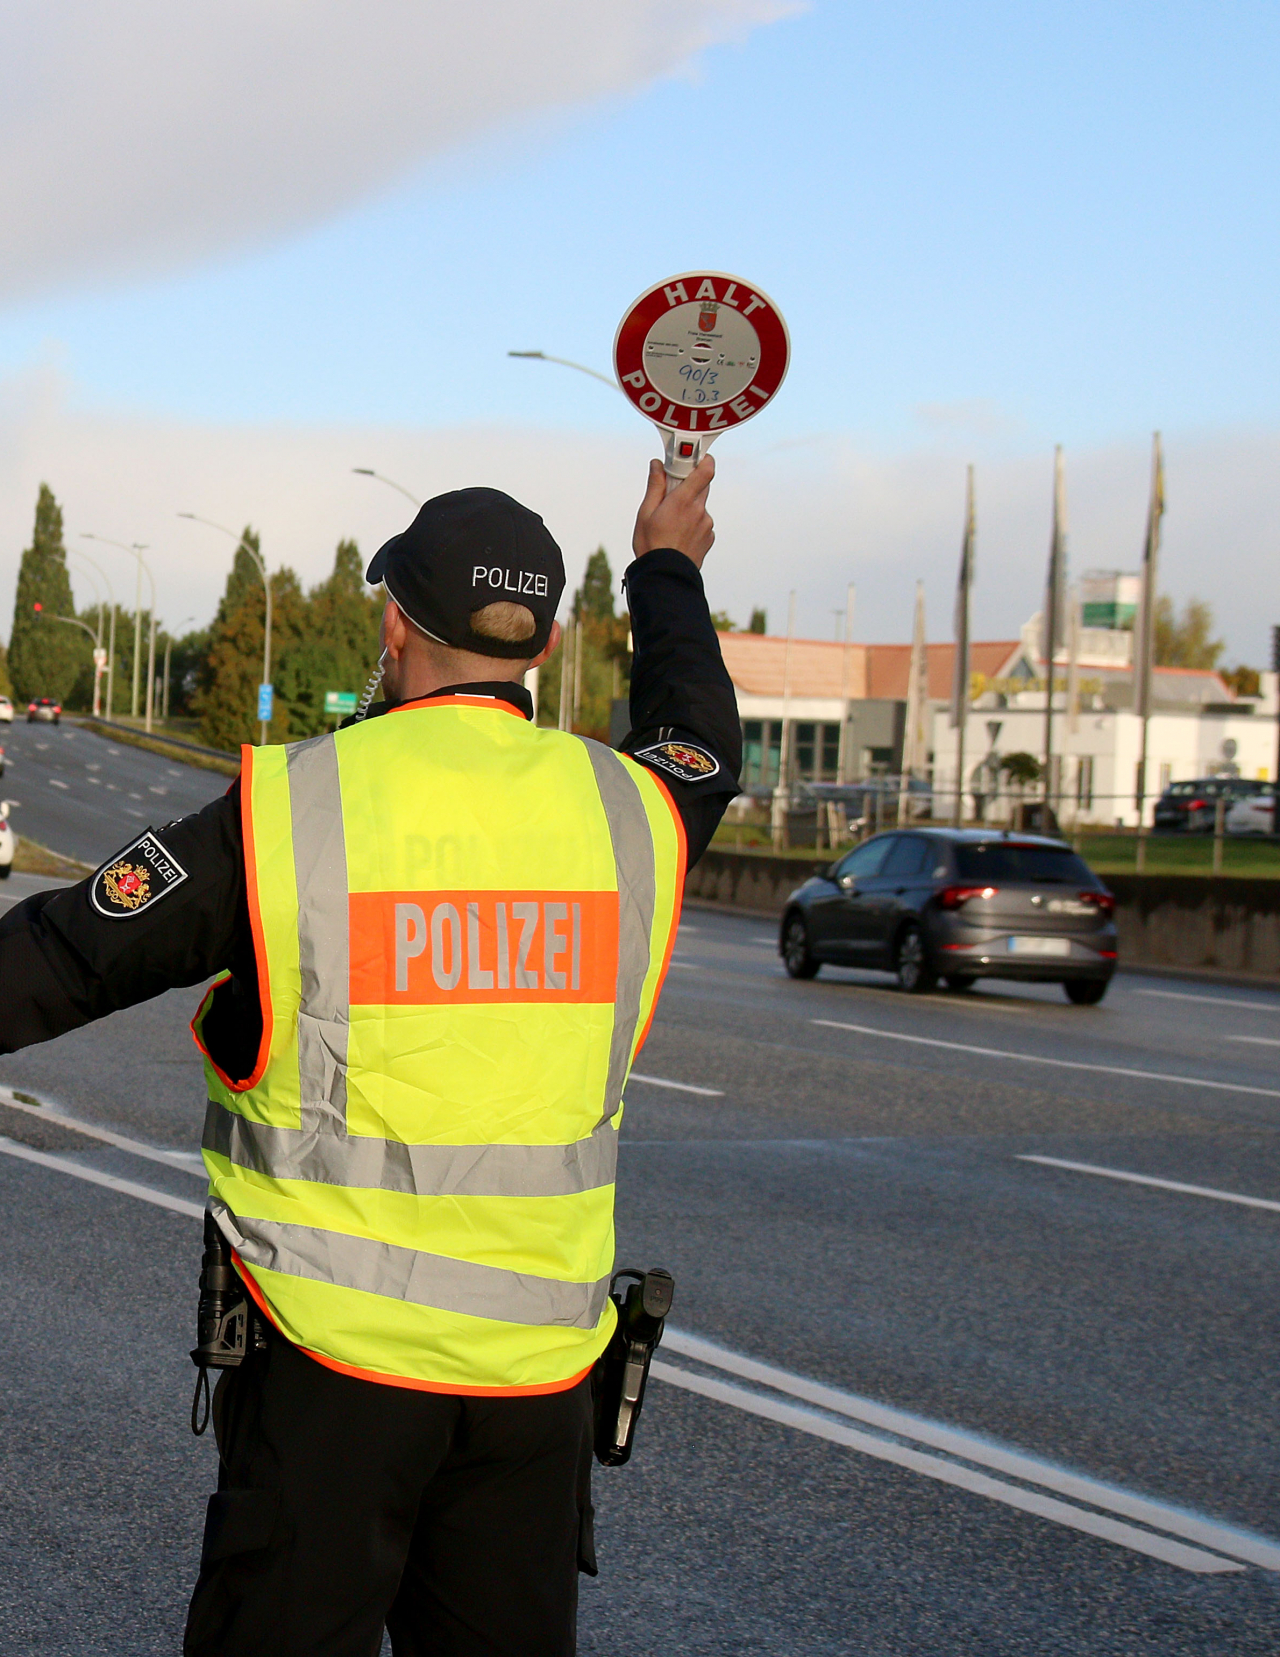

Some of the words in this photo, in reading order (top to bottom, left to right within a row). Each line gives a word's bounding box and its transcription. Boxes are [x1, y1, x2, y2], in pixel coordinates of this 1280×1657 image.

[663, 278, 766, 317] HALT
[678, 364, 719, 386] 90/3
[621, 369, 770, 430] POLIZEI
[472, 565, 548, 597] POLIZEI
[643, 751, 694, 779] POLIZEI
[138, 840, 179, 884] POLIZEI
[395, 901, 581, 992] POLIZEI
